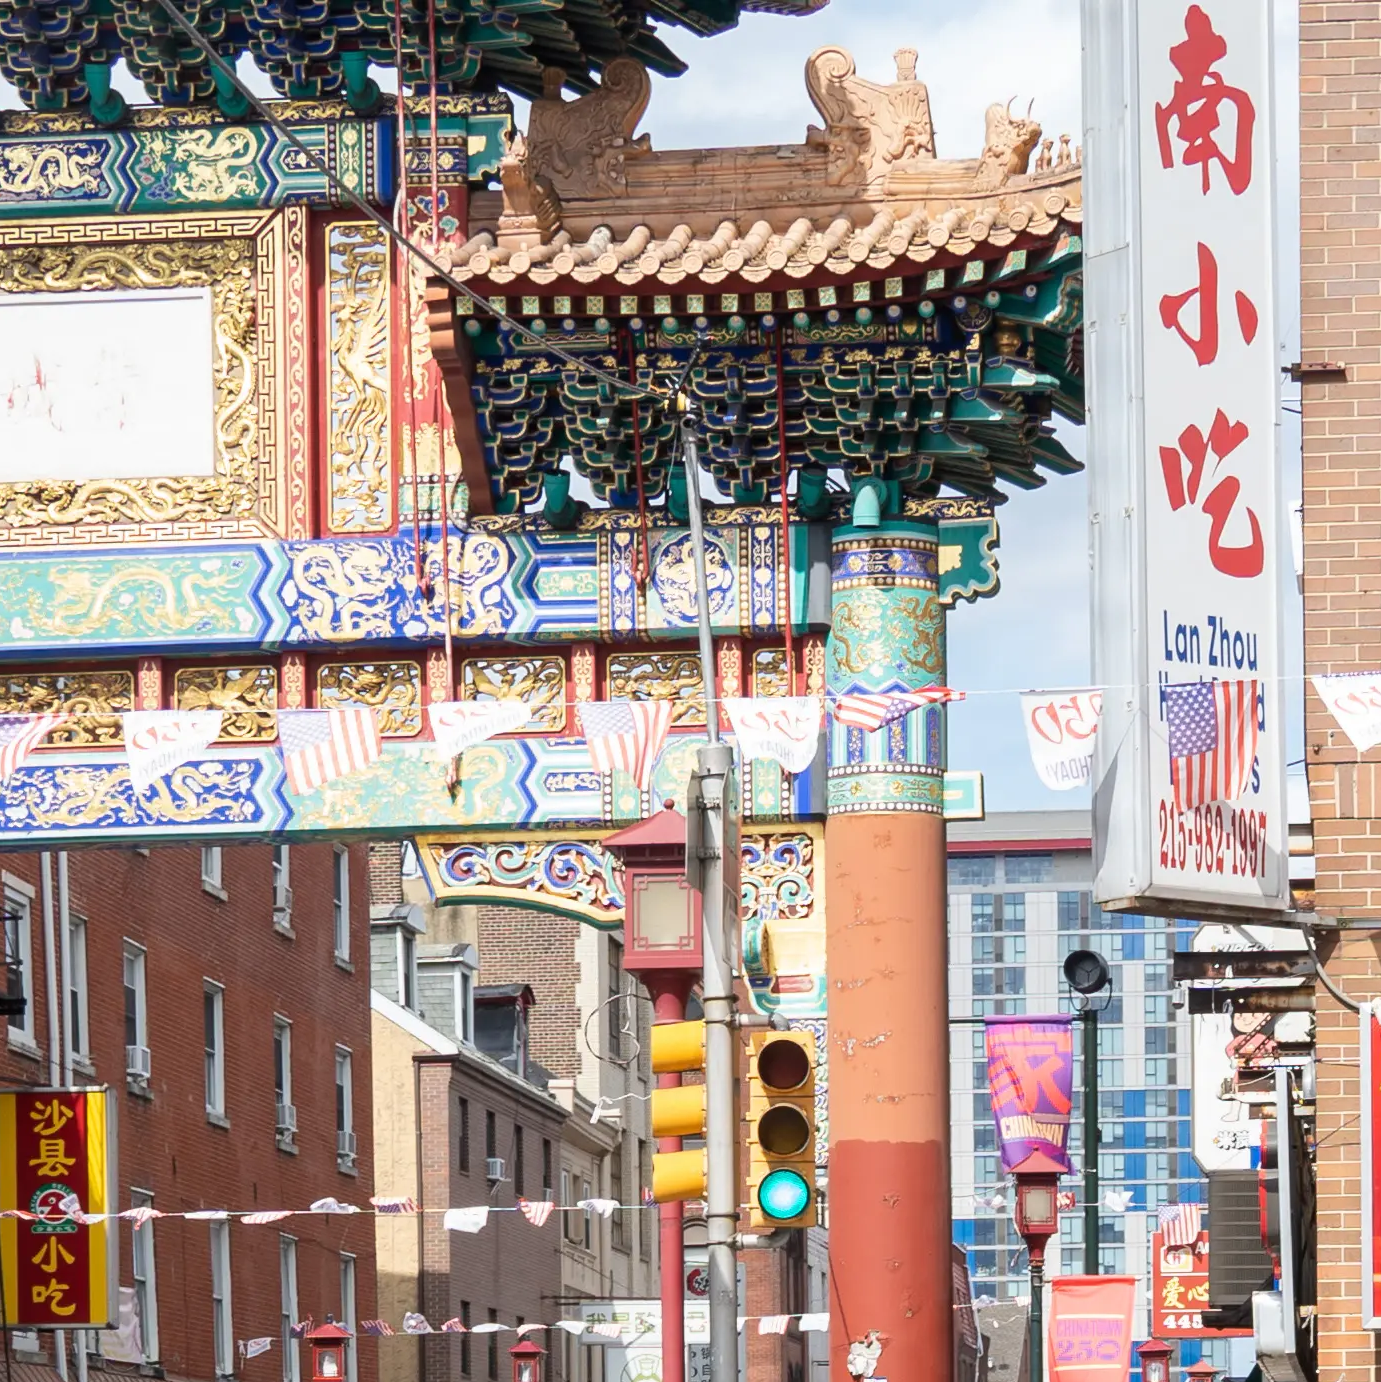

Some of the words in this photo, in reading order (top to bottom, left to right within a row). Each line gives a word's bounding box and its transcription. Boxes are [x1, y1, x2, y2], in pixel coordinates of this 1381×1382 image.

[1164, 610, 1201, 664] Lan
[1207, 615, 1258, 672] Zhou
[1159, 799, 1268, 879] 215-982-1997
